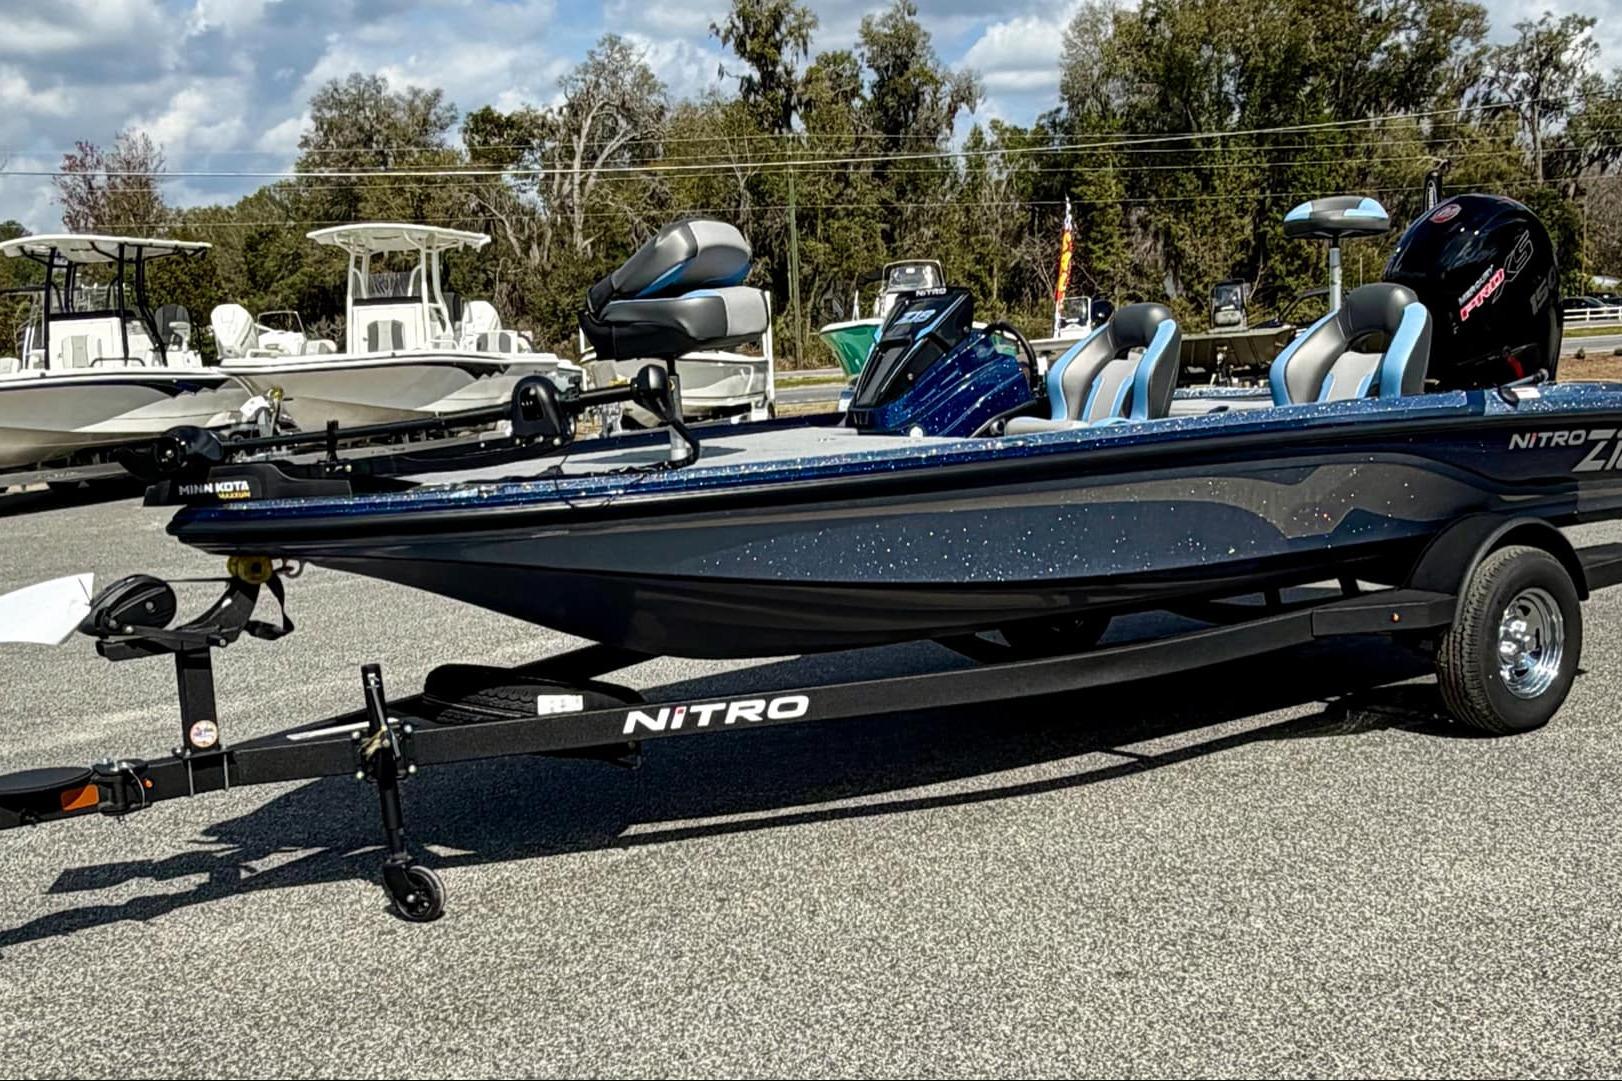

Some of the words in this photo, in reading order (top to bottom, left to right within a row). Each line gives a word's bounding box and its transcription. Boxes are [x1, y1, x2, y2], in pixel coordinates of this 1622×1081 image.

[1460, 267, 1505, 322] PRO
[1508, 429, 1587, 450] NITRO
[1571, 428, 1622, 473] Z1
[179, 482, 213, 496] MINN
[214, 480, 250, 493] KOTA
[622, 694, 810, 735] NITRO
